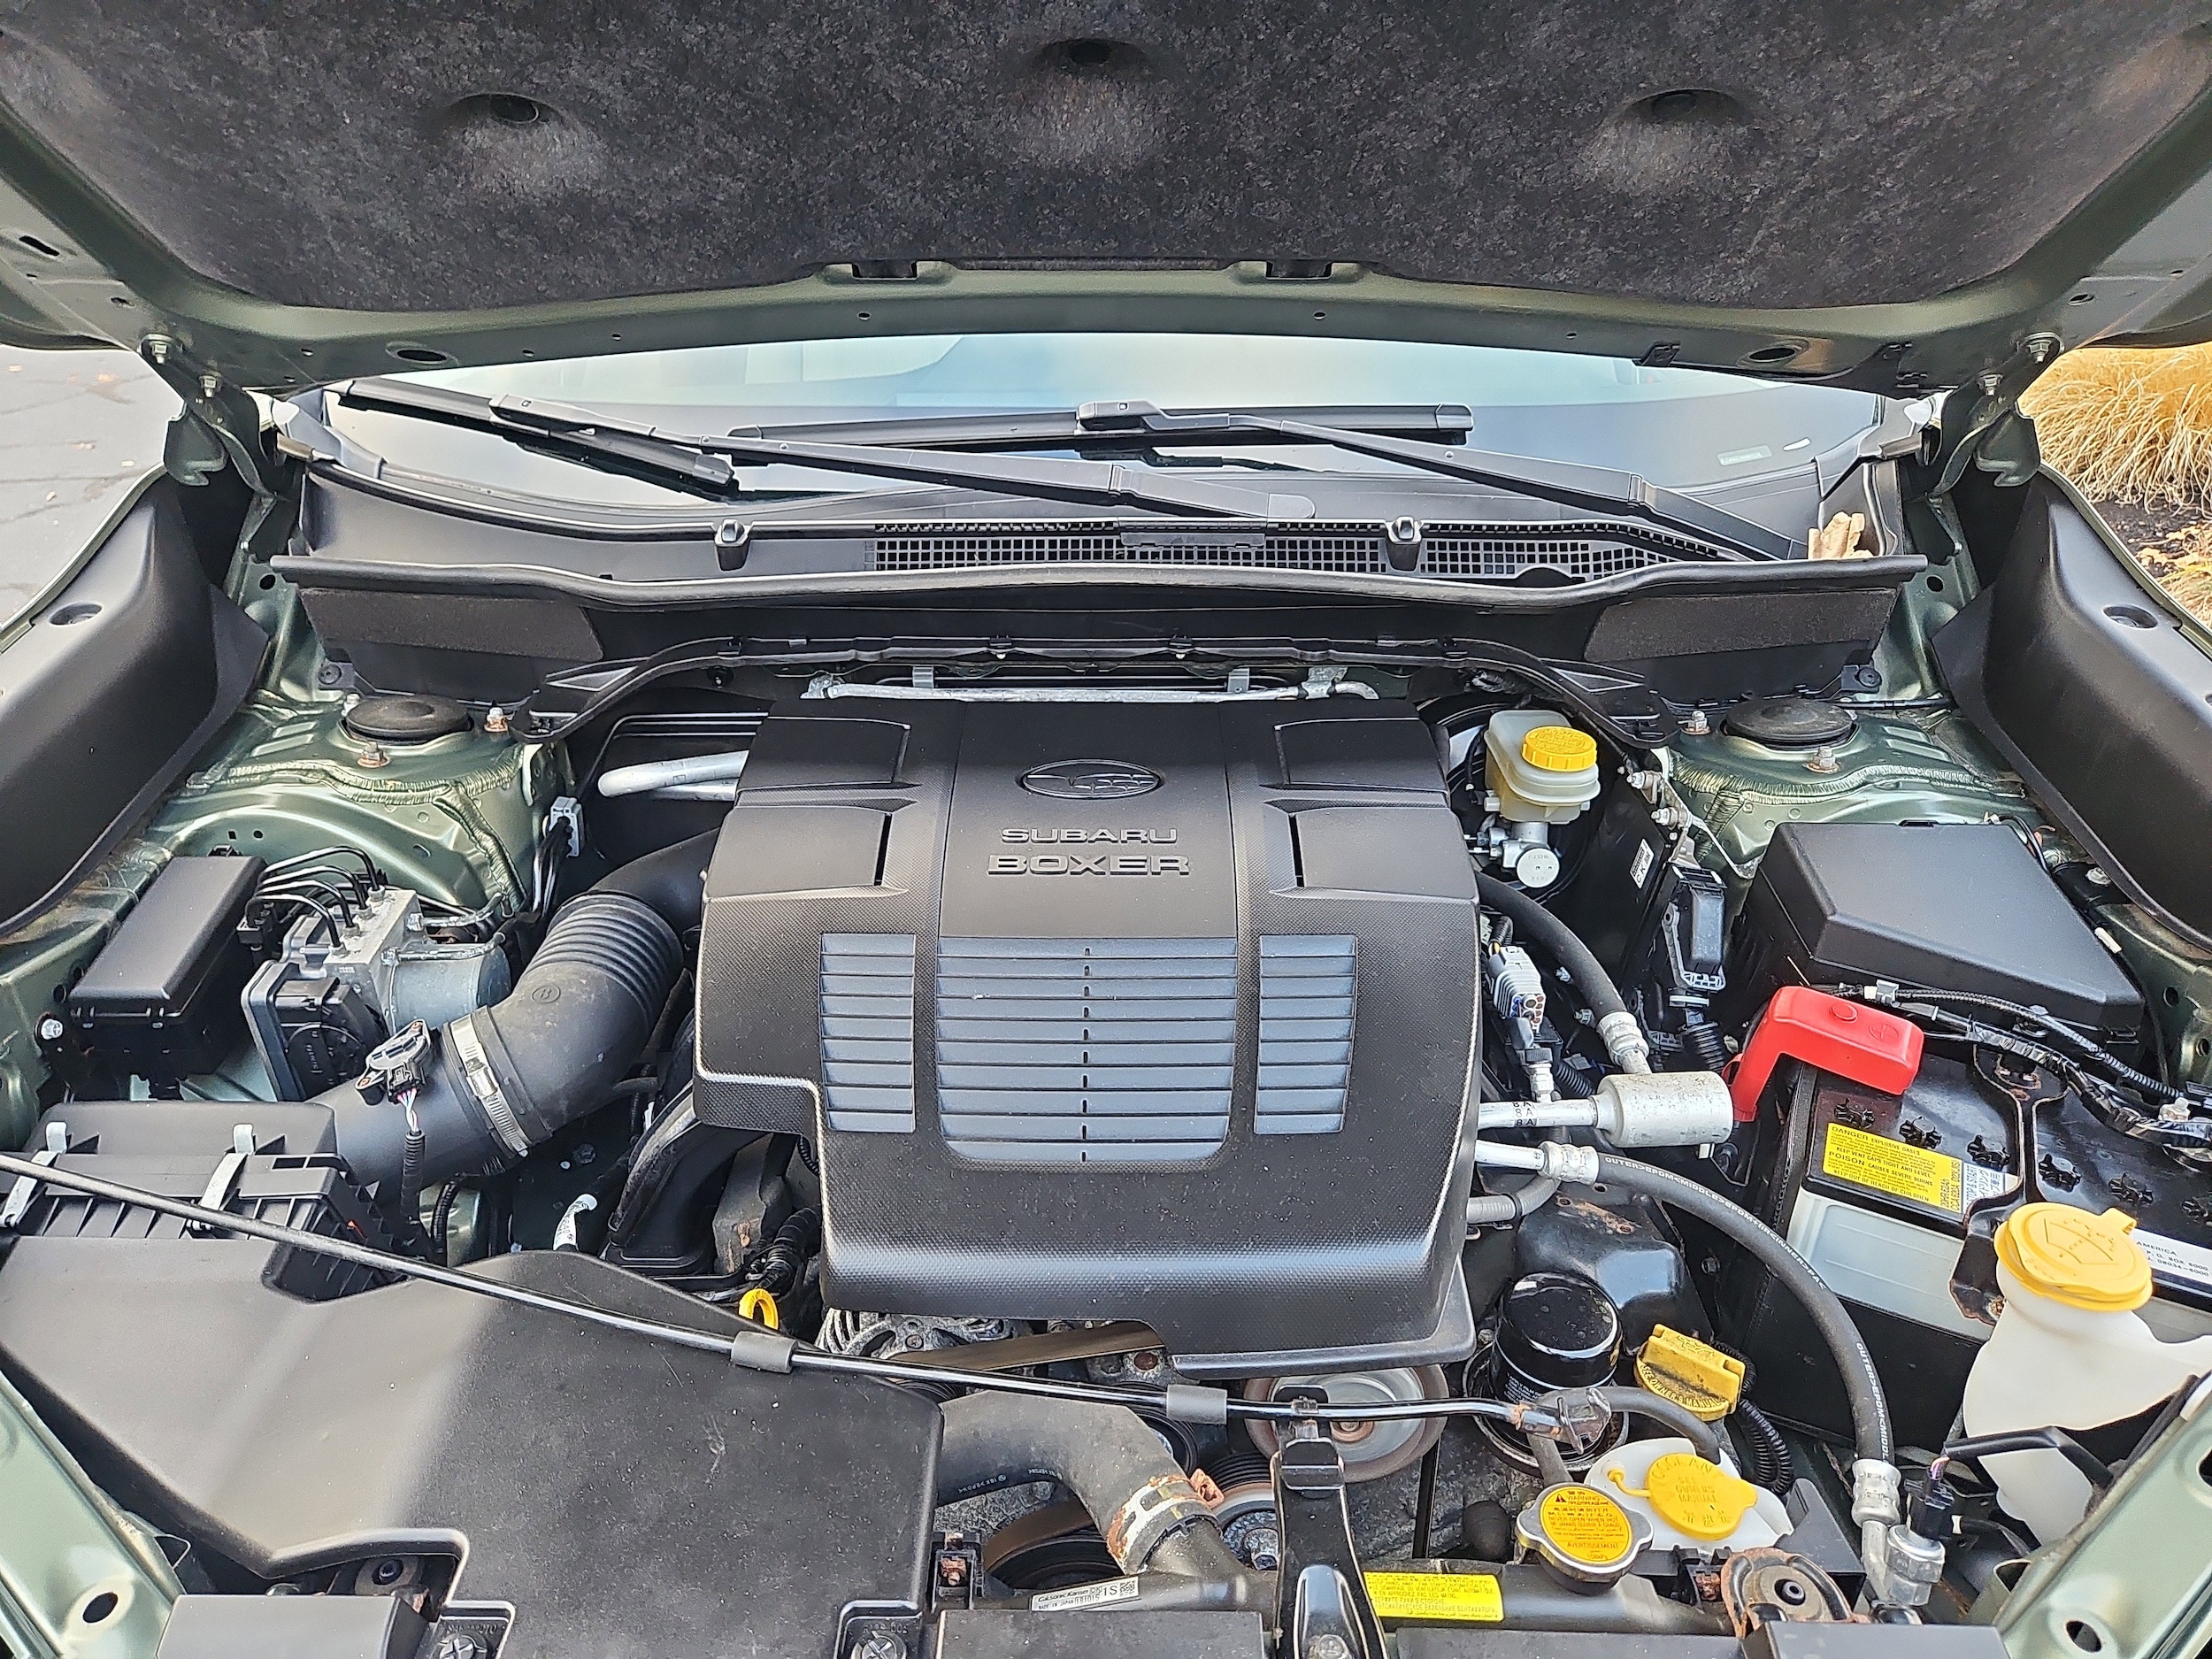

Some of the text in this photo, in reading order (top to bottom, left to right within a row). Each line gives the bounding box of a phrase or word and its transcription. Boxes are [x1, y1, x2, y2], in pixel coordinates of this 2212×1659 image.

[1002, 829, 1177, 843] SUBARU
[988, 855, 1189, 875] BOXER
[1832, 1125, 1868, 1141] DANGER
[1829, 1150, 1864, 1166] POISON
[1868, 1162, 1889, 1173] CAUSES
[1833, 1168, 1847, 1177] KEEP
[1870, 1179, 1889, 1189] REACH
[1914, 1169, 1931, 1178] LEVEL
[1978, 1168, 1988, 1199] イドリング
[2137, 1241, 2177, 1256] AMERICA
[2169, 1256, 2185, 1265] BOX
[1641, 1364, 1653, 1379] SEE
[1686, 1397, 1722, 1408] MANUAL
[1856, 1342, 1889, 1463] OUTER>EPDM<MIDDL
